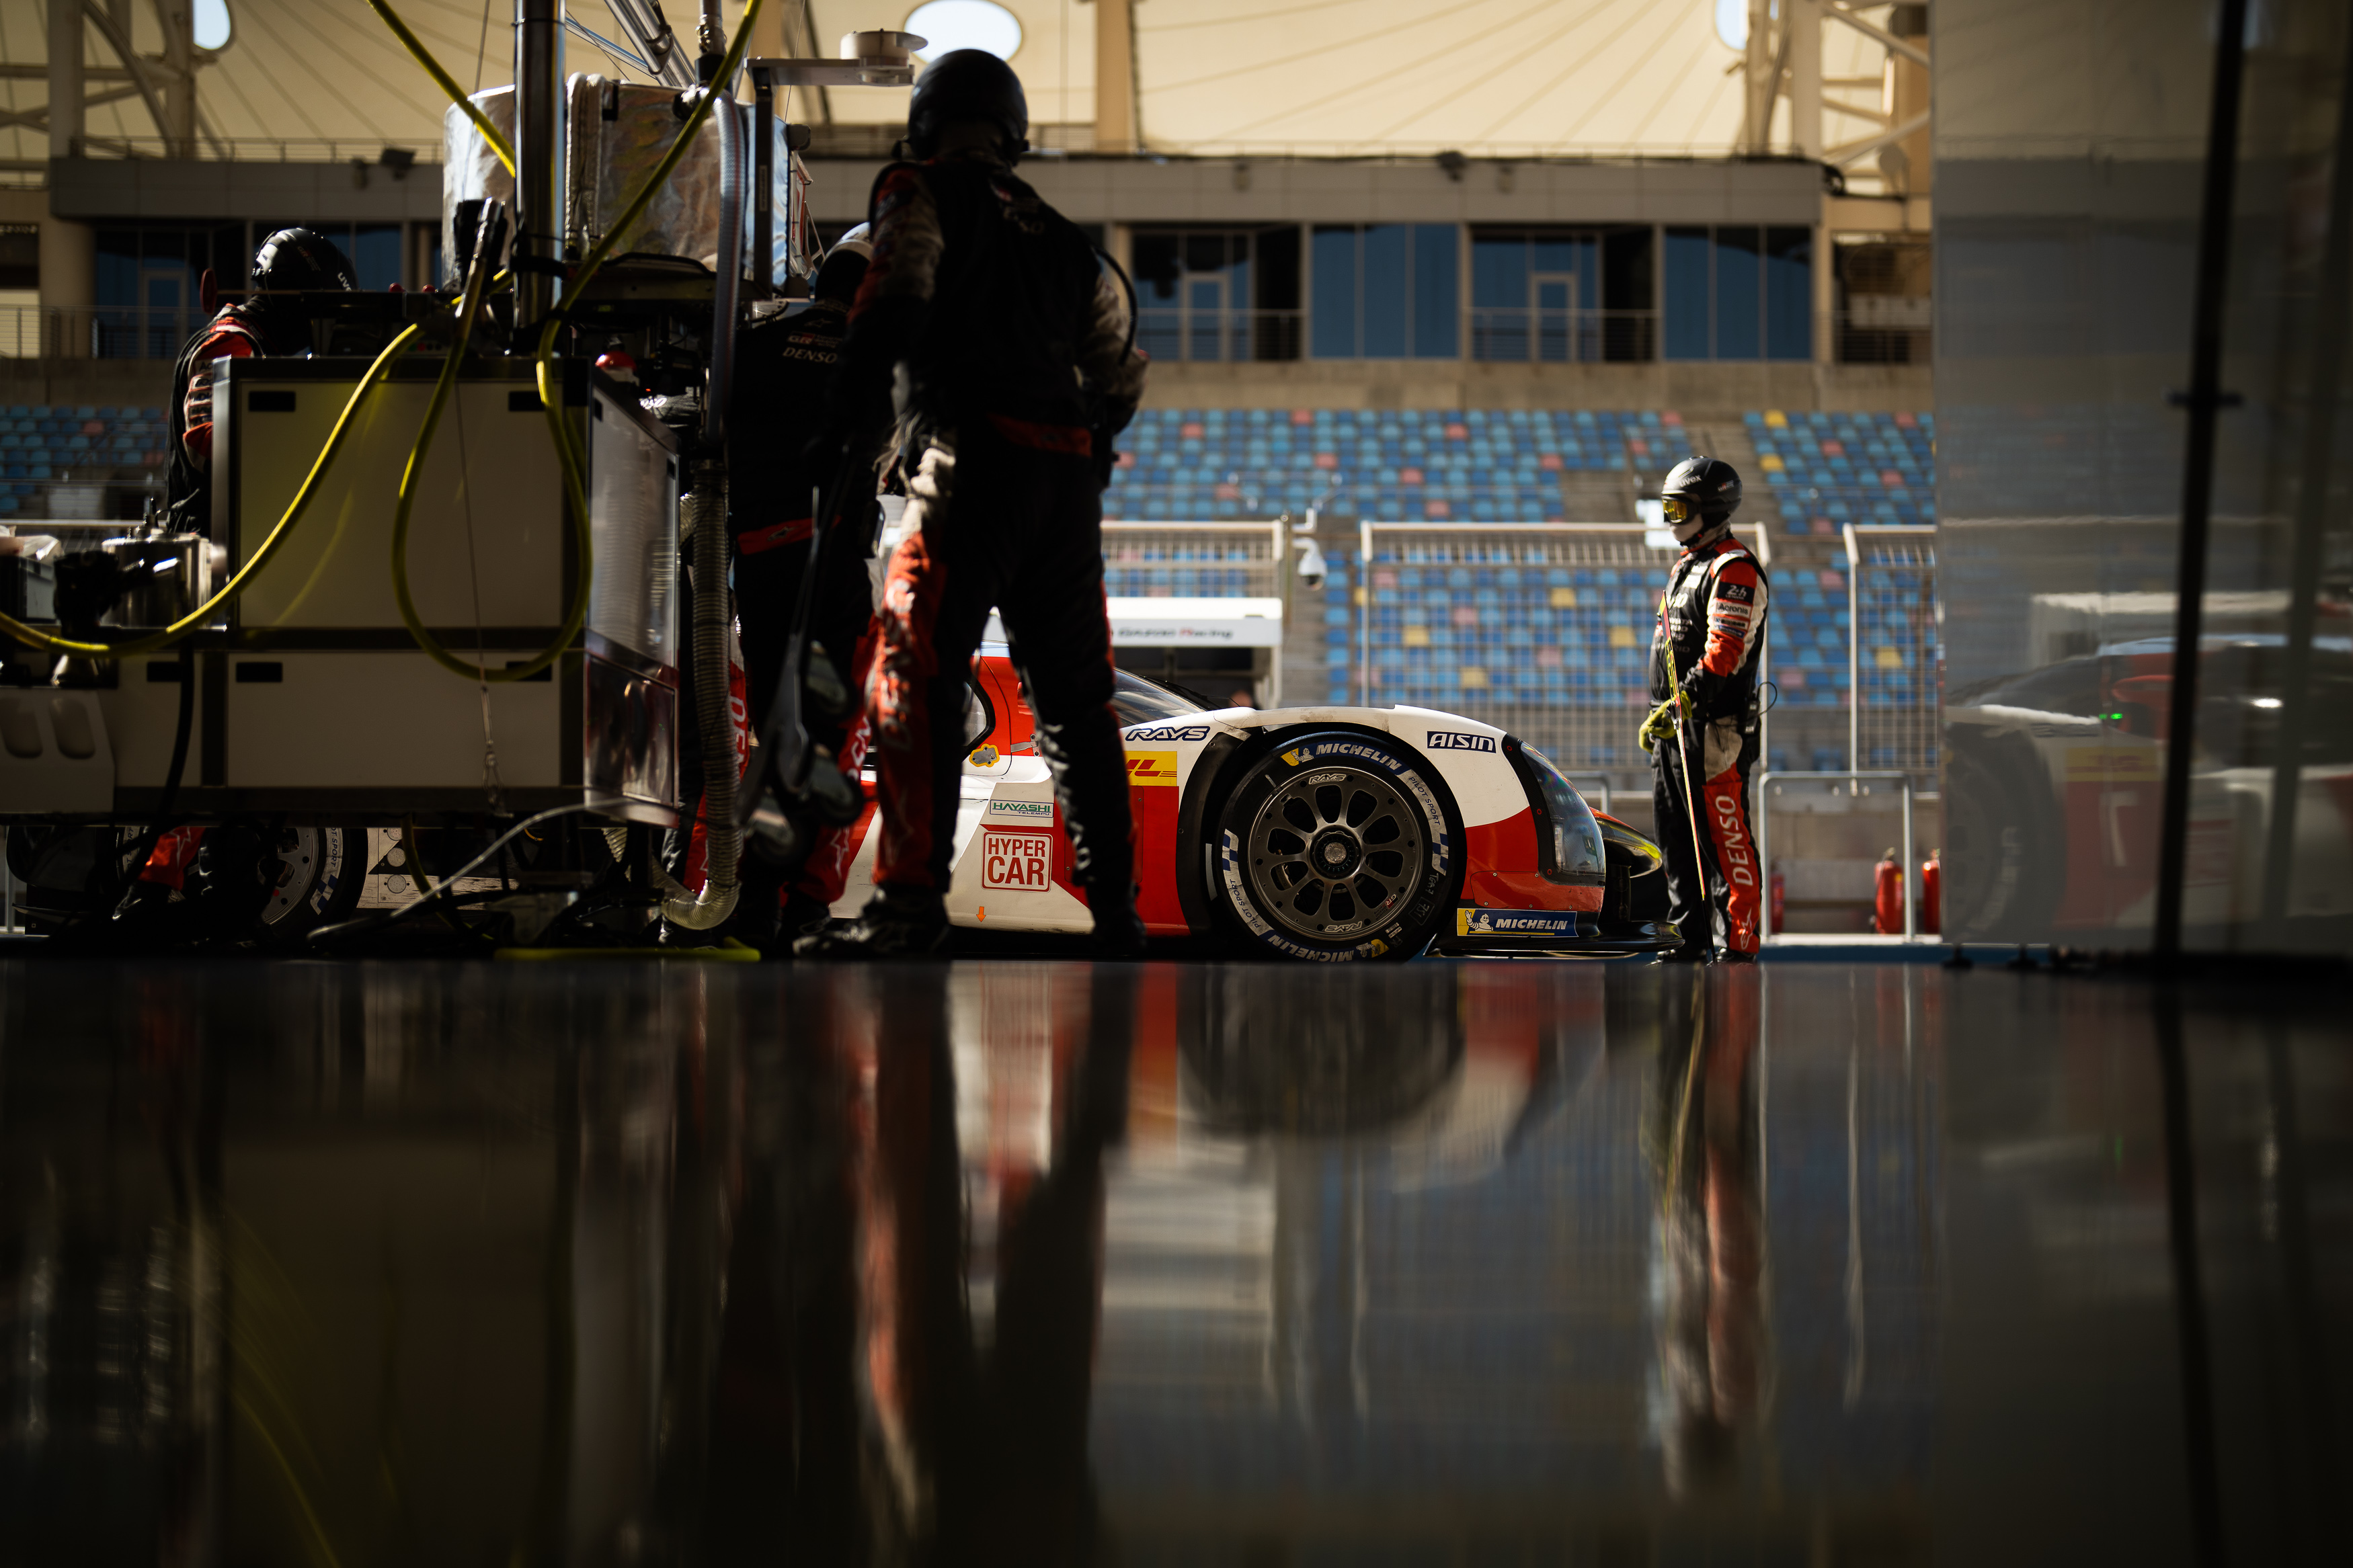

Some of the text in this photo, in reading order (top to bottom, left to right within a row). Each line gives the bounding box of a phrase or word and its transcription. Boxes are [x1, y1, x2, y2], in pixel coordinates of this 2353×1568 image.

[782, 346, 838, 364] DENSO
[1680, 474, 1702, 488] uvex
[1718, 604, 1748, 614] Acronis
[1125, 726, 1210, 741] RAYS
[1429, 733, 1493, 751] AISIN
[1316, 743, 1402, 771] MICHELIN
[1308, 774, 1347, 785] RAYS
[993, 802, 1051, 812] HAYASHI
[1409, 776, 1441, 825] PILOT SPORT
[988, 838, 1046, 858] HYPER
[1716, 795, 1753, 886] DENSO
[330, 837, 338, 868] SPORT
[988, 856, 1045, 886] CAR
[1230, 879, 1261, 928] PILOT SPORT
[1386, 893, 1398, 907] GR
[1324, 921, 1362, 932] RAYS
[1494, 919, 1568, 930] MICHELIN
[1267, 934, 1354, 962] MICHELIN
